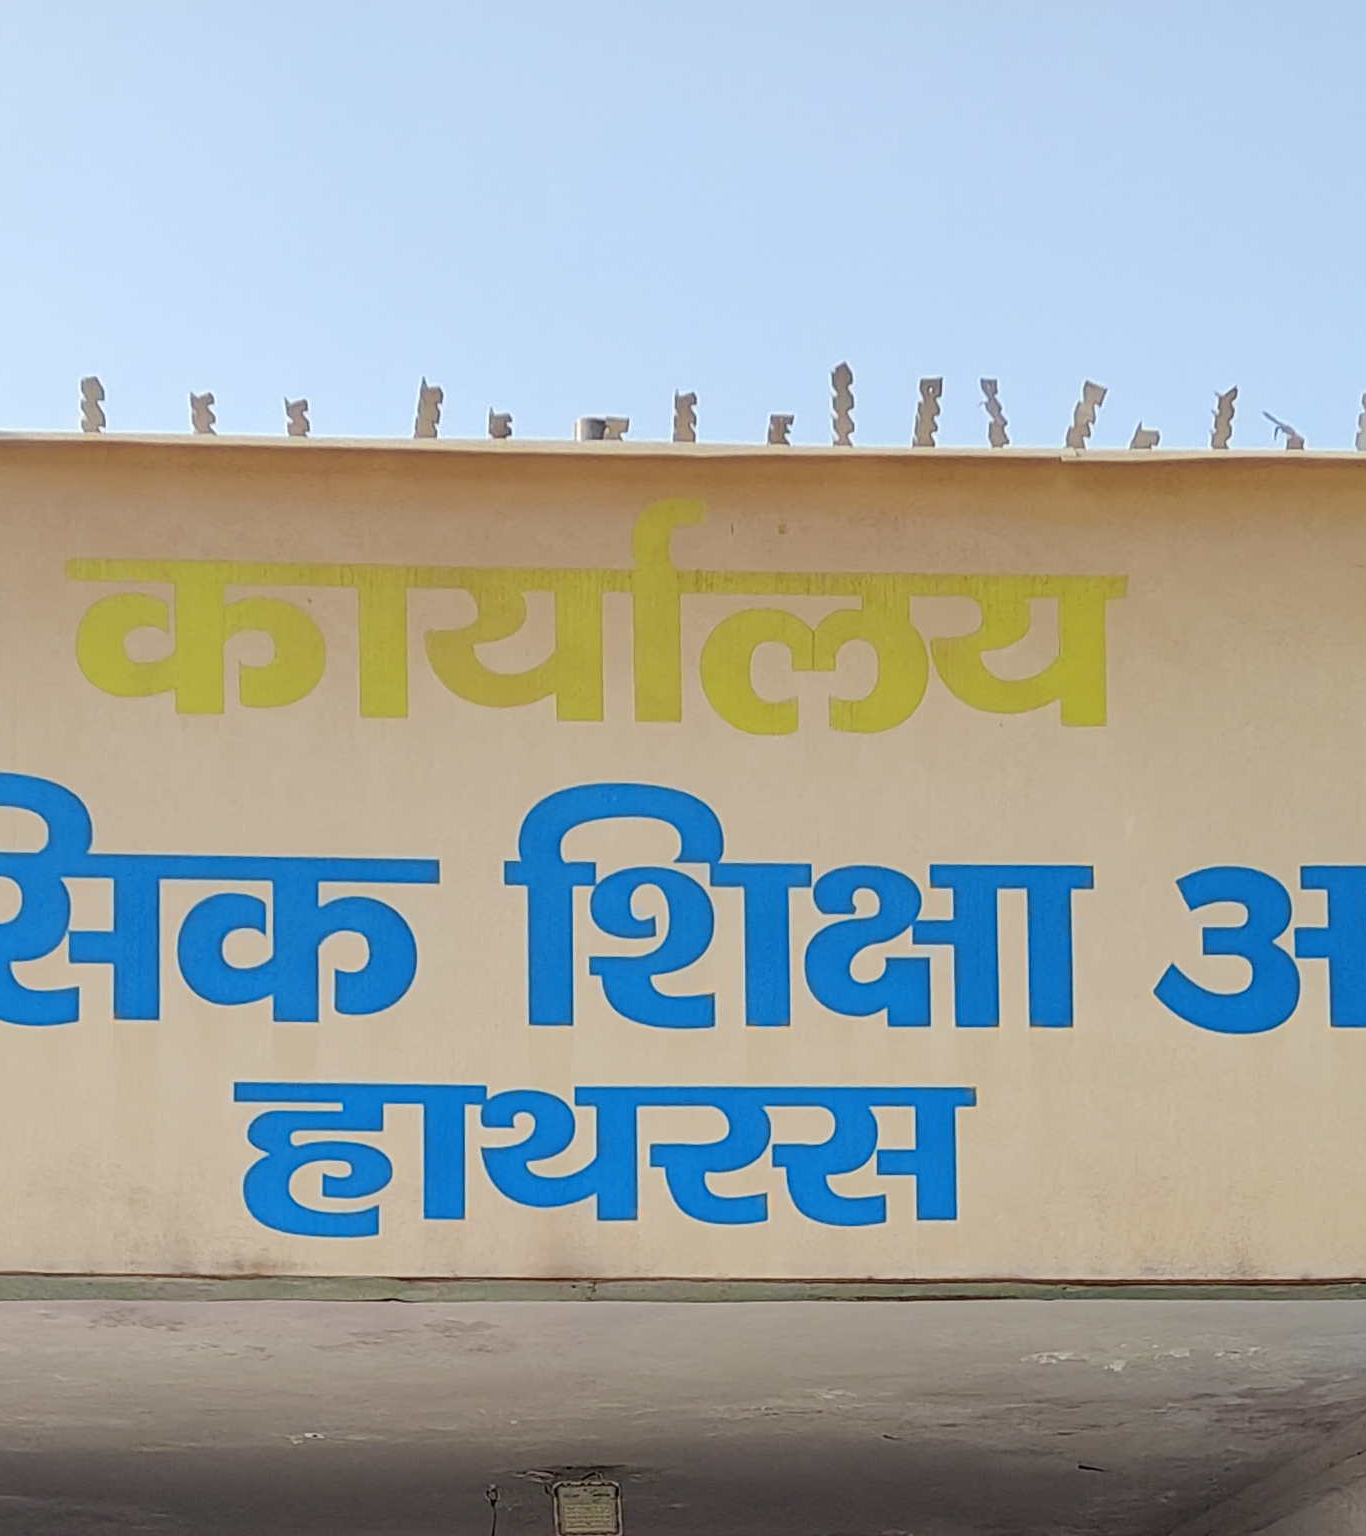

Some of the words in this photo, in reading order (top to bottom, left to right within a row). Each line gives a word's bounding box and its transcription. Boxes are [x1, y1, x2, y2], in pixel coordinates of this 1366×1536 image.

[65, 497, 1129, 736] कार्यालय
[504, 782, 1094, 1034] शिक्षा
[233, 1081, 977, 1238] हाथरस
